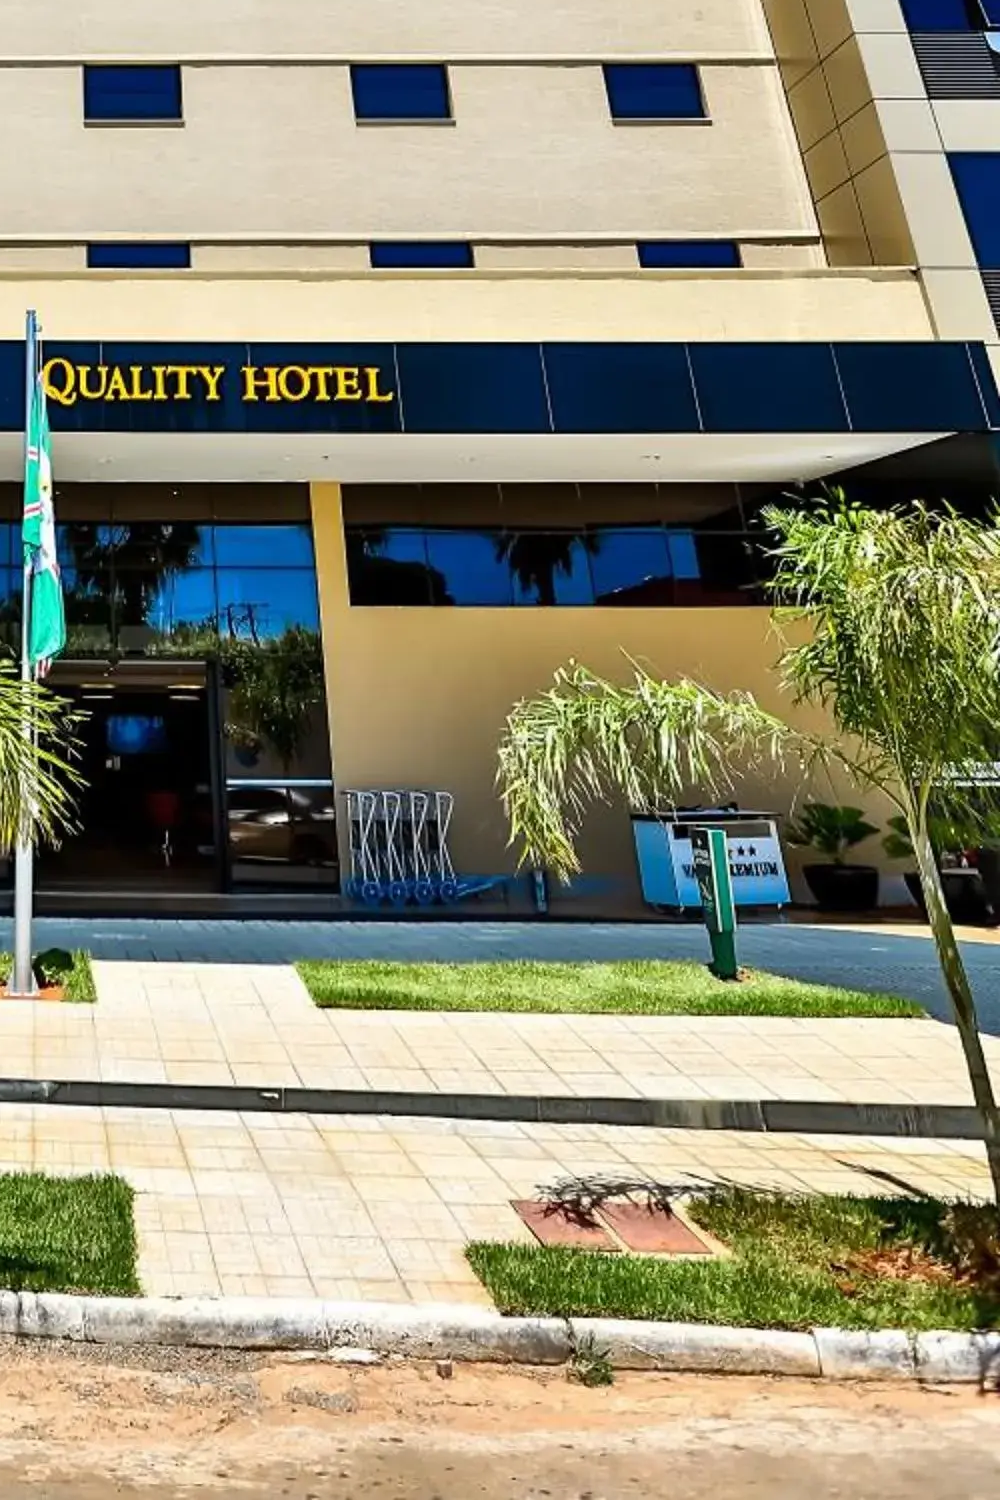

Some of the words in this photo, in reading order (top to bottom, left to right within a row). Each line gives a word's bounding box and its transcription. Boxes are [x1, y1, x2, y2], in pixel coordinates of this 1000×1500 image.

[42, 357, 225, 406] QUALITY
[241, 366, 394, 402] HOTEL
[730, 862, 779, 877] REMIUM
